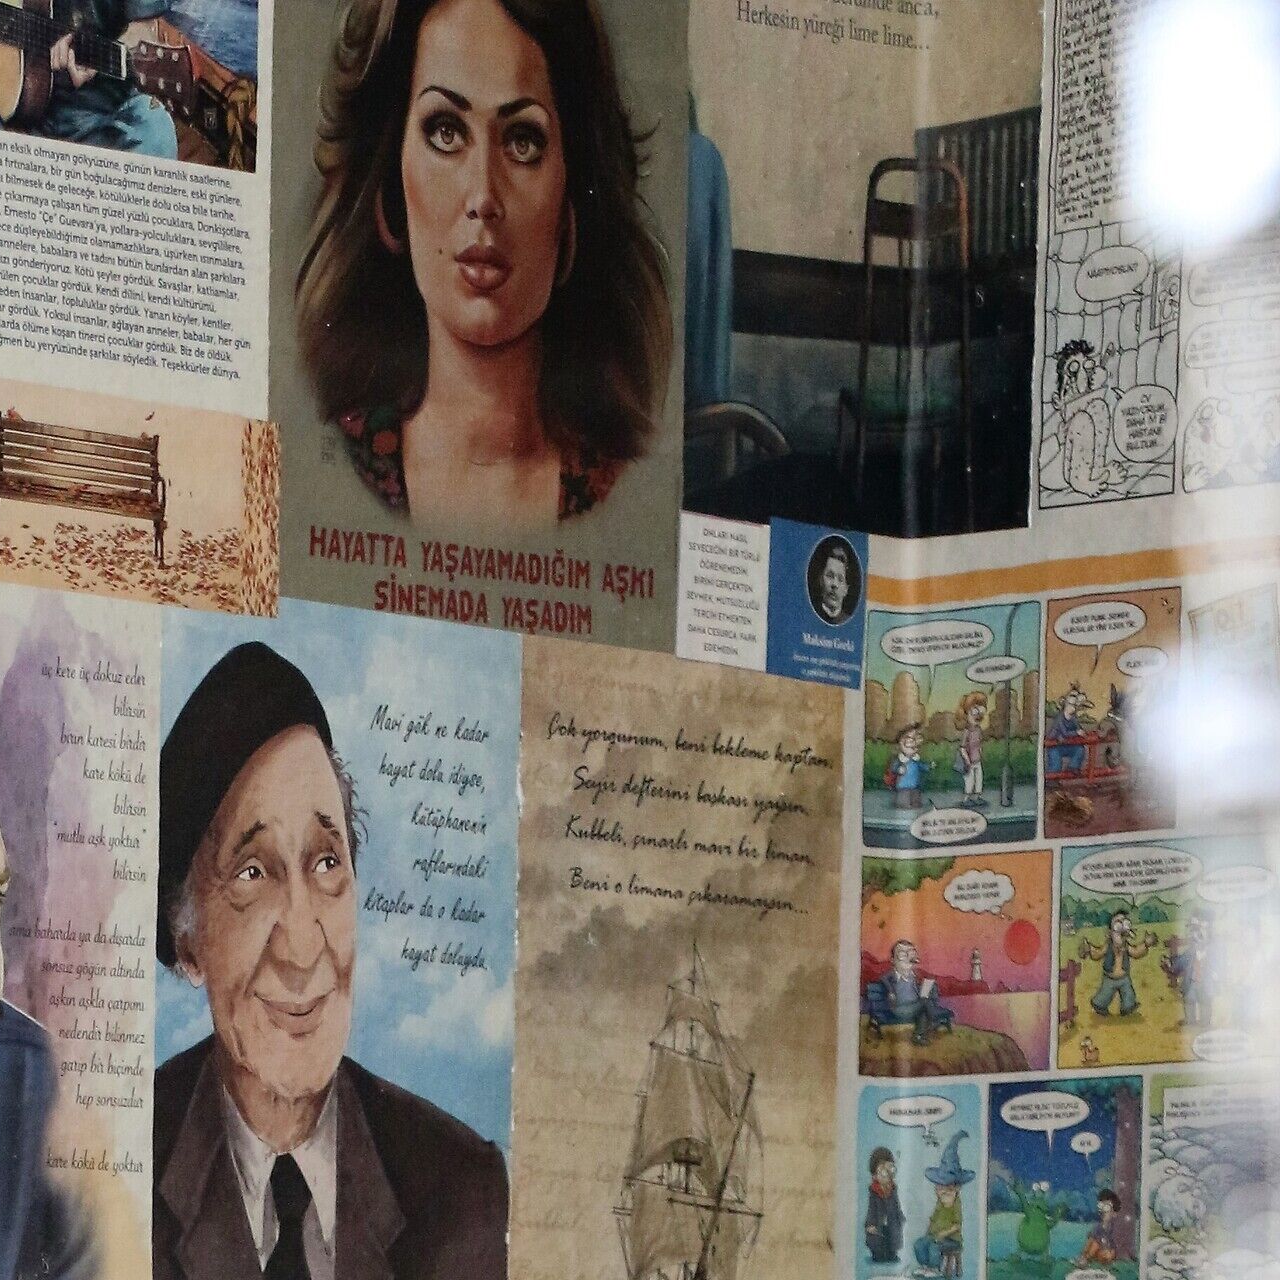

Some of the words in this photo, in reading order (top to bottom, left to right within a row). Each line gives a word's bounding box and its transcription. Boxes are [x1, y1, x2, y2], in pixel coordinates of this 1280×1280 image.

[850, 20, 878, 43] lime
[25, 337, 35, 348] bu
[309, 526, 408, 569] HAYATTA
[421, 540, 591, 590] YAŞAYAMADIĞIM
[602, 562, 655, 600] AŞKI
[375, 574, 488, 624] SİNEMADA
[502, 596, 593, 636] YAŞADIM
[57, 656, 76, 679] kere
[125, 664, 146, 686] eder
[370, 704, 403, 732] Mavi
[407, 712, 432, 742] gök
[436, 725, 447, 739] ne
[454, 717, 489, 744] kadar
[379, 753, 416, 787] hayat
[420, 759, 444, 784] dolu
[362, 886, 413, 922] kitaplar
[420, 895, 434, 919] da
[438, 905, 445, 919] o
[451, 898, 486, 923] kadar
[401, 938, 437, 972] hayat
